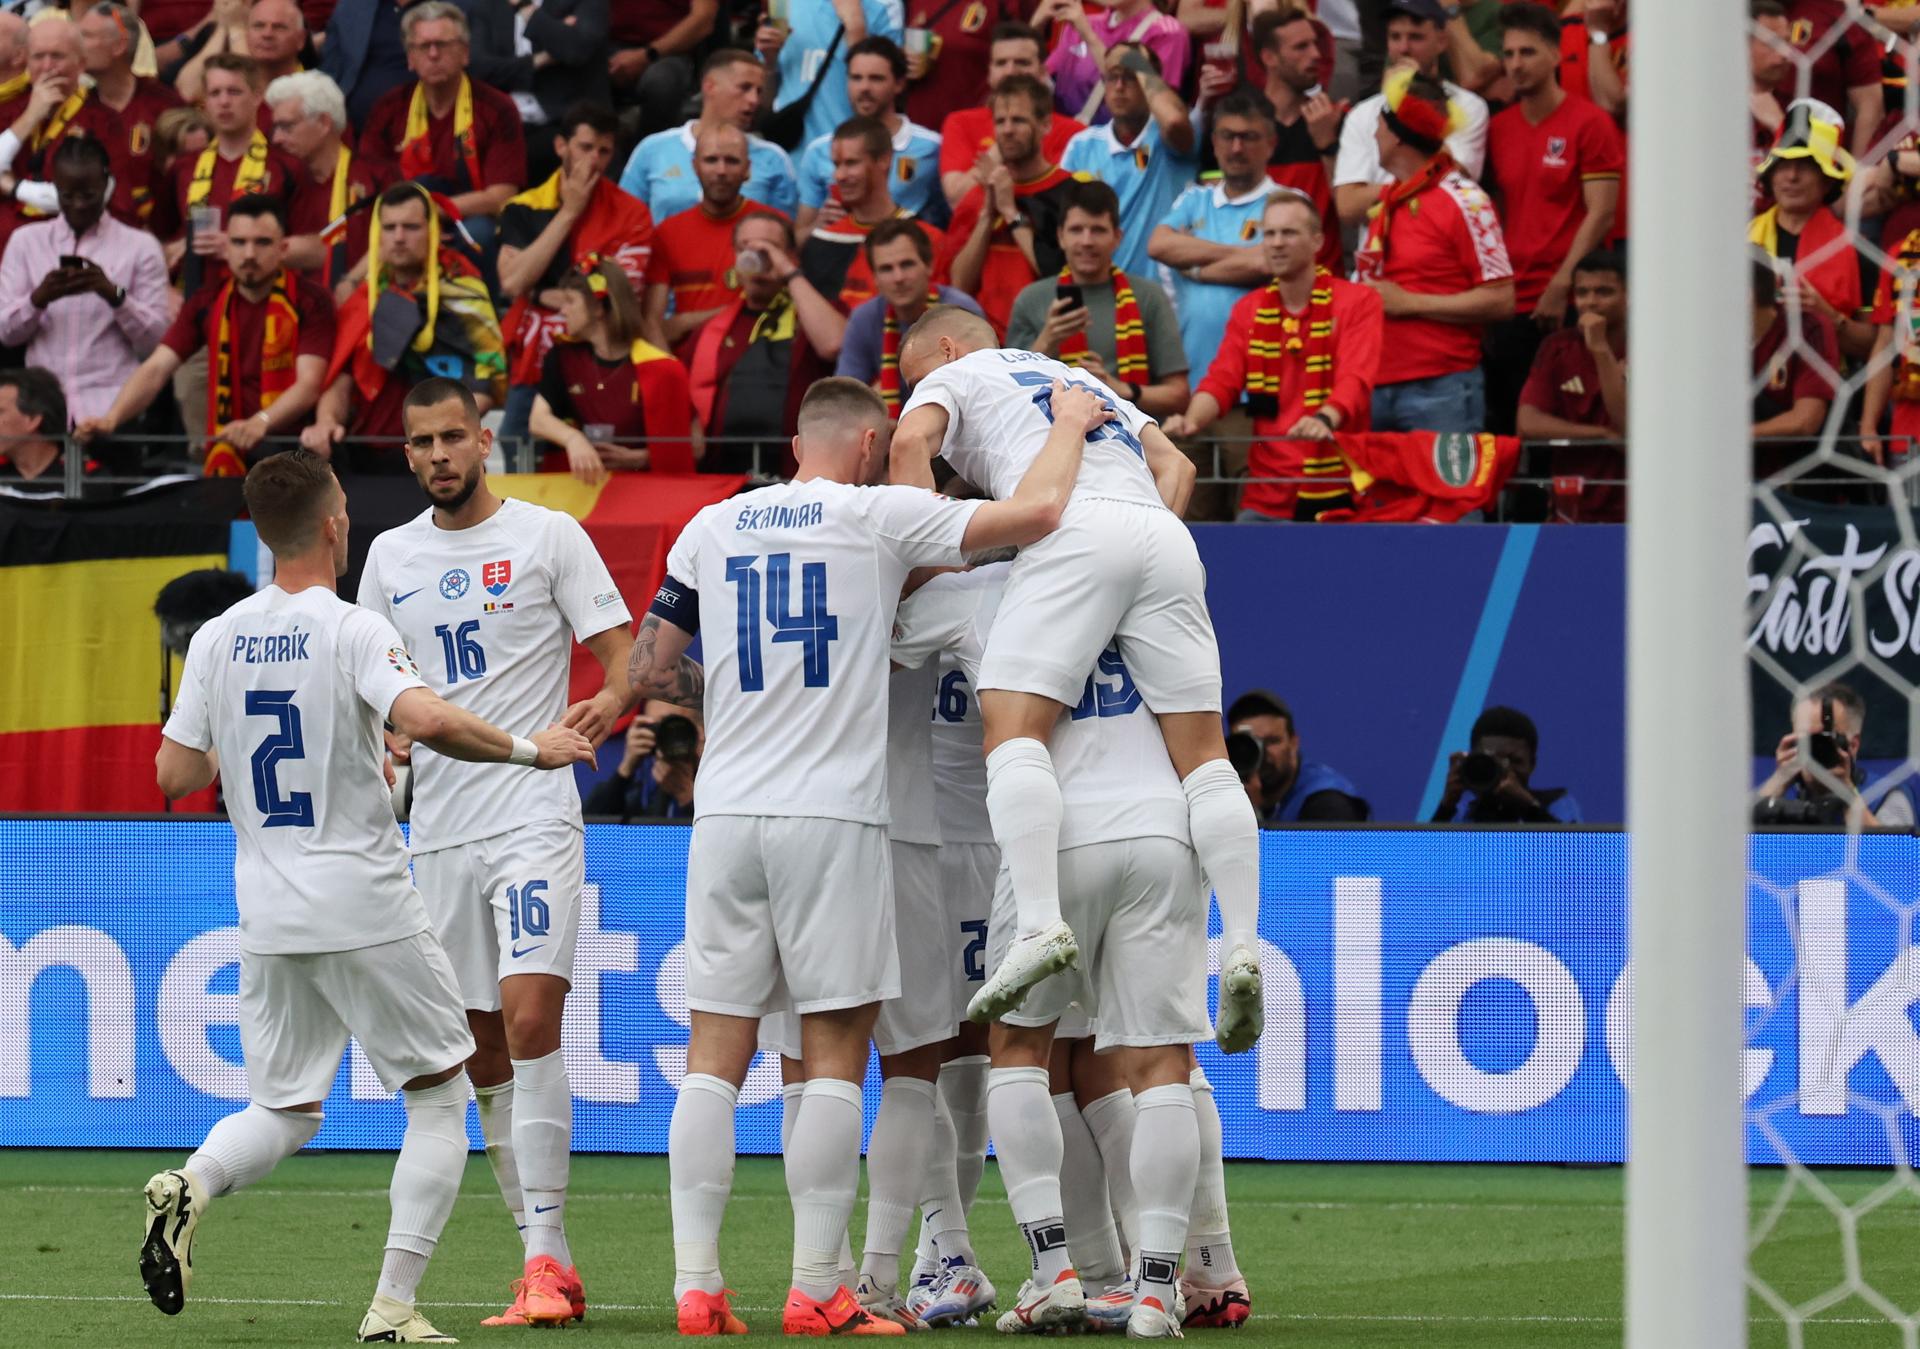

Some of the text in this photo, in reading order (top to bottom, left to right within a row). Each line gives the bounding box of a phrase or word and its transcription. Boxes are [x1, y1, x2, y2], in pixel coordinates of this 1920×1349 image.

[736, 501, 823, 530] ŠKRINIAR
[725, 552, 839, 692] 14
[1870, 550, 1920, 658] S
[434, 619, 487, 684] 16
[931, 669, 969, 723] 6
[245, 690, 315, 828] 2
[506, 880, 549, 940] 16
